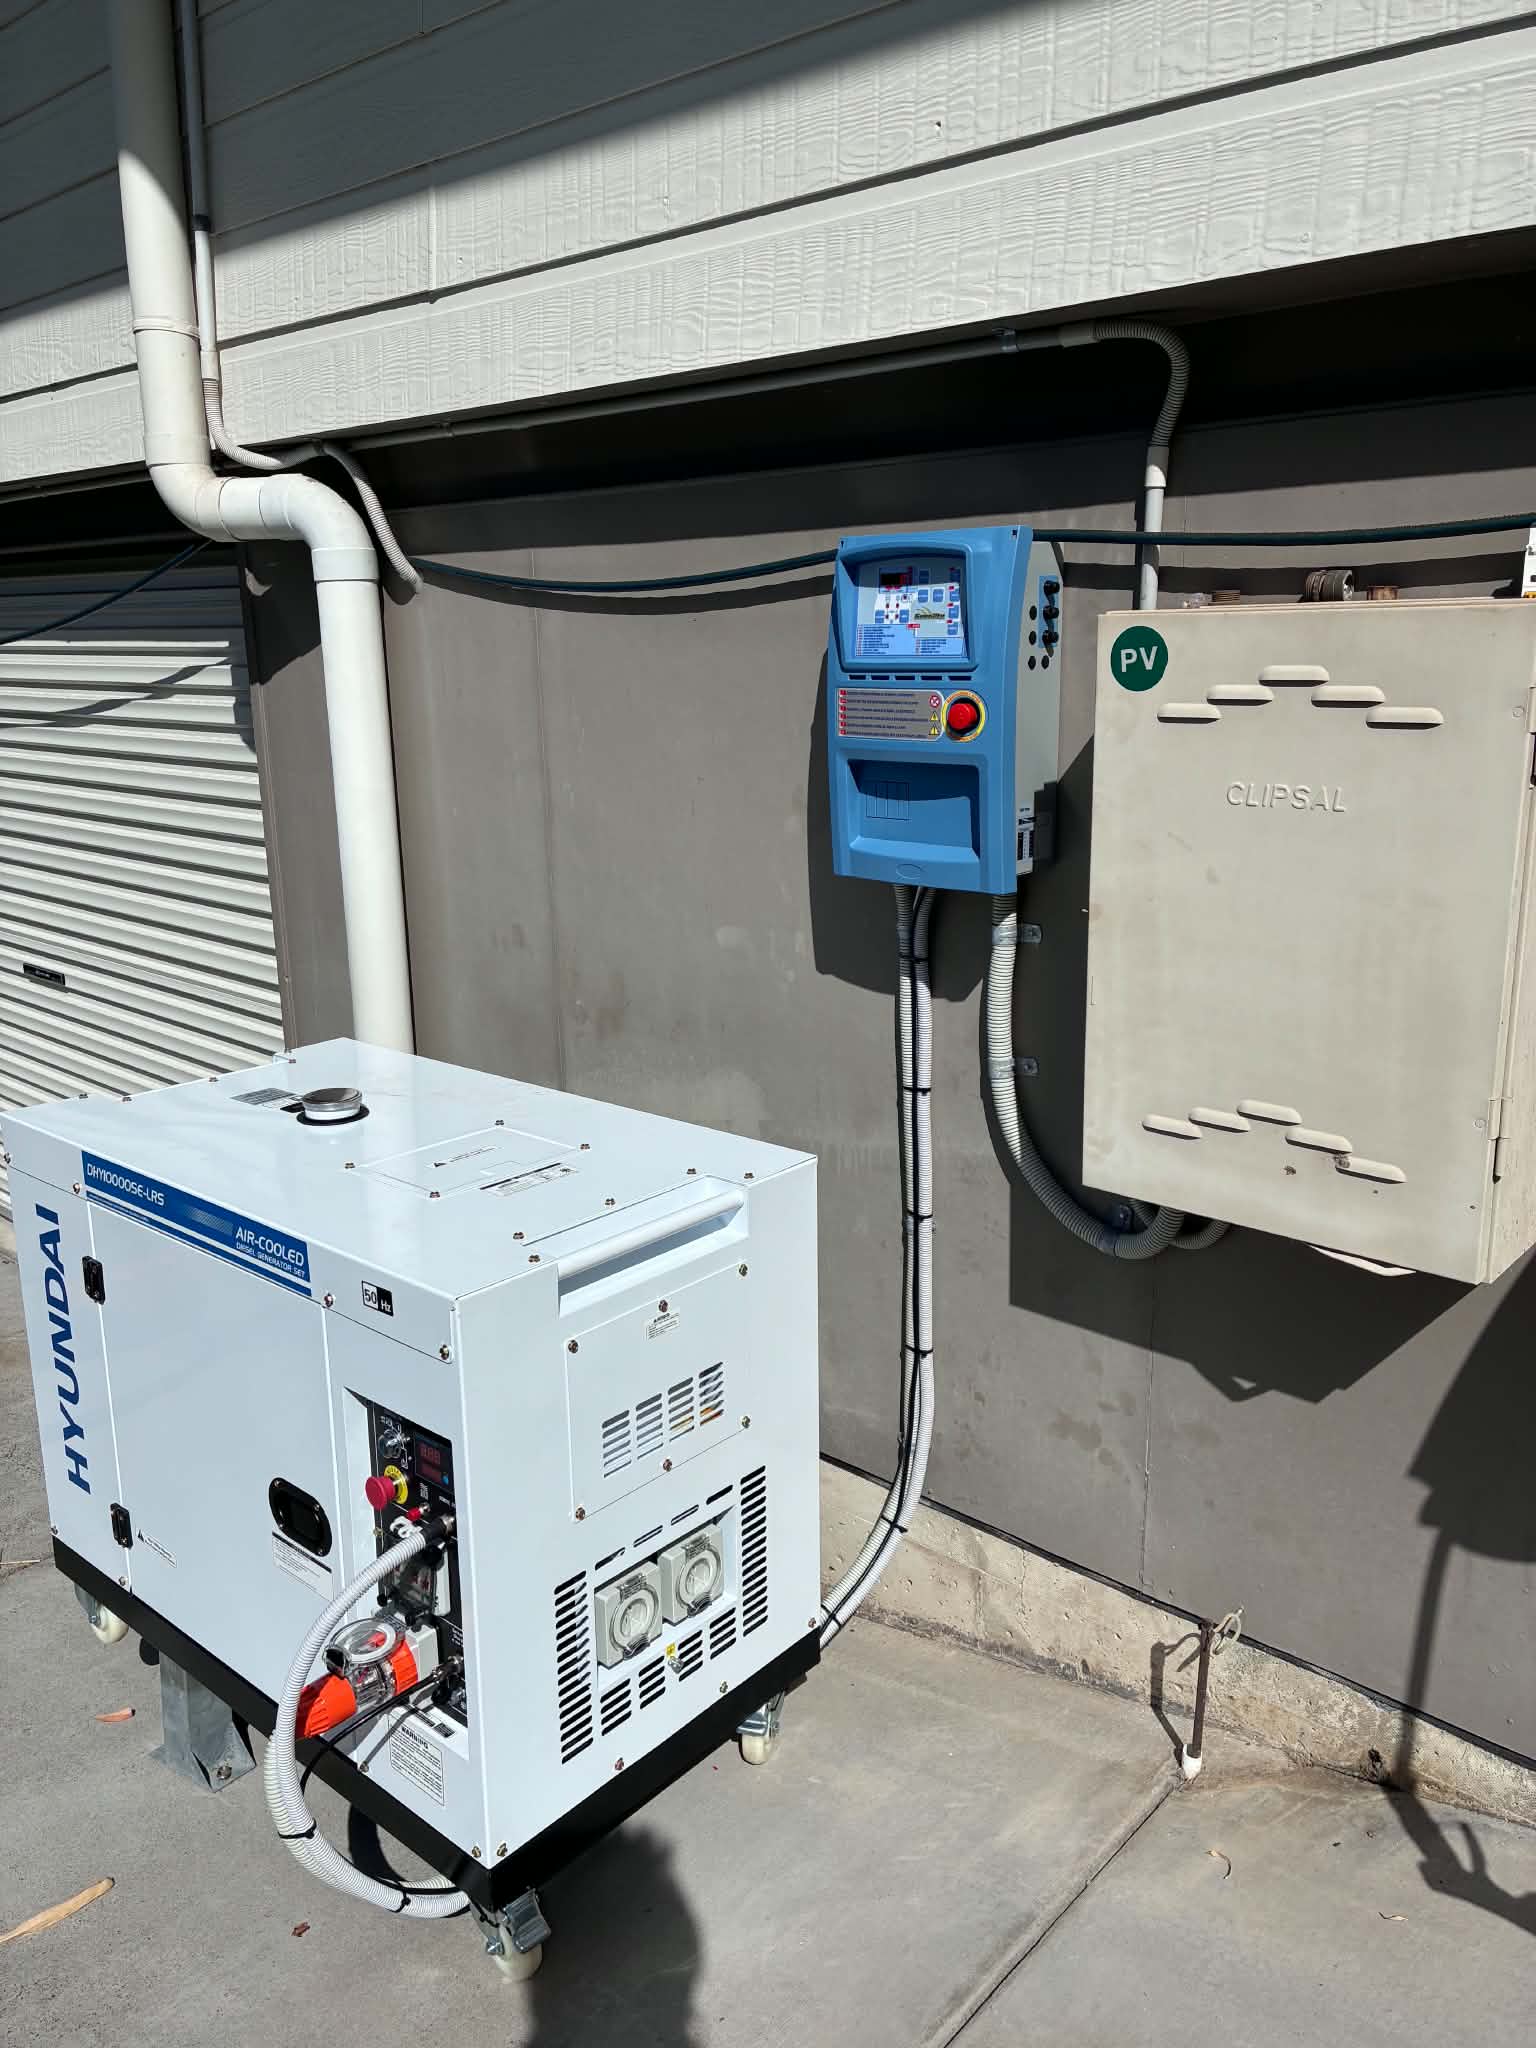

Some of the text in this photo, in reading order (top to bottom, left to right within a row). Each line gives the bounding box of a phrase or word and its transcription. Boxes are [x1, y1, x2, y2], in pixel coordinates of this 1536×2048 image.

[1120, 645, 1158, 673] PV
[1226, 781, 1347, 813] CLIPSAL
[235, 1226, 304, 1267] AIR-COOLED
[236, 1241, 306, 1278] DIESEL GENERATOR SET
[364, 1288, 392, 1313] 50 Hz
[35, 1203, 92, 1496] HYUNDAI
